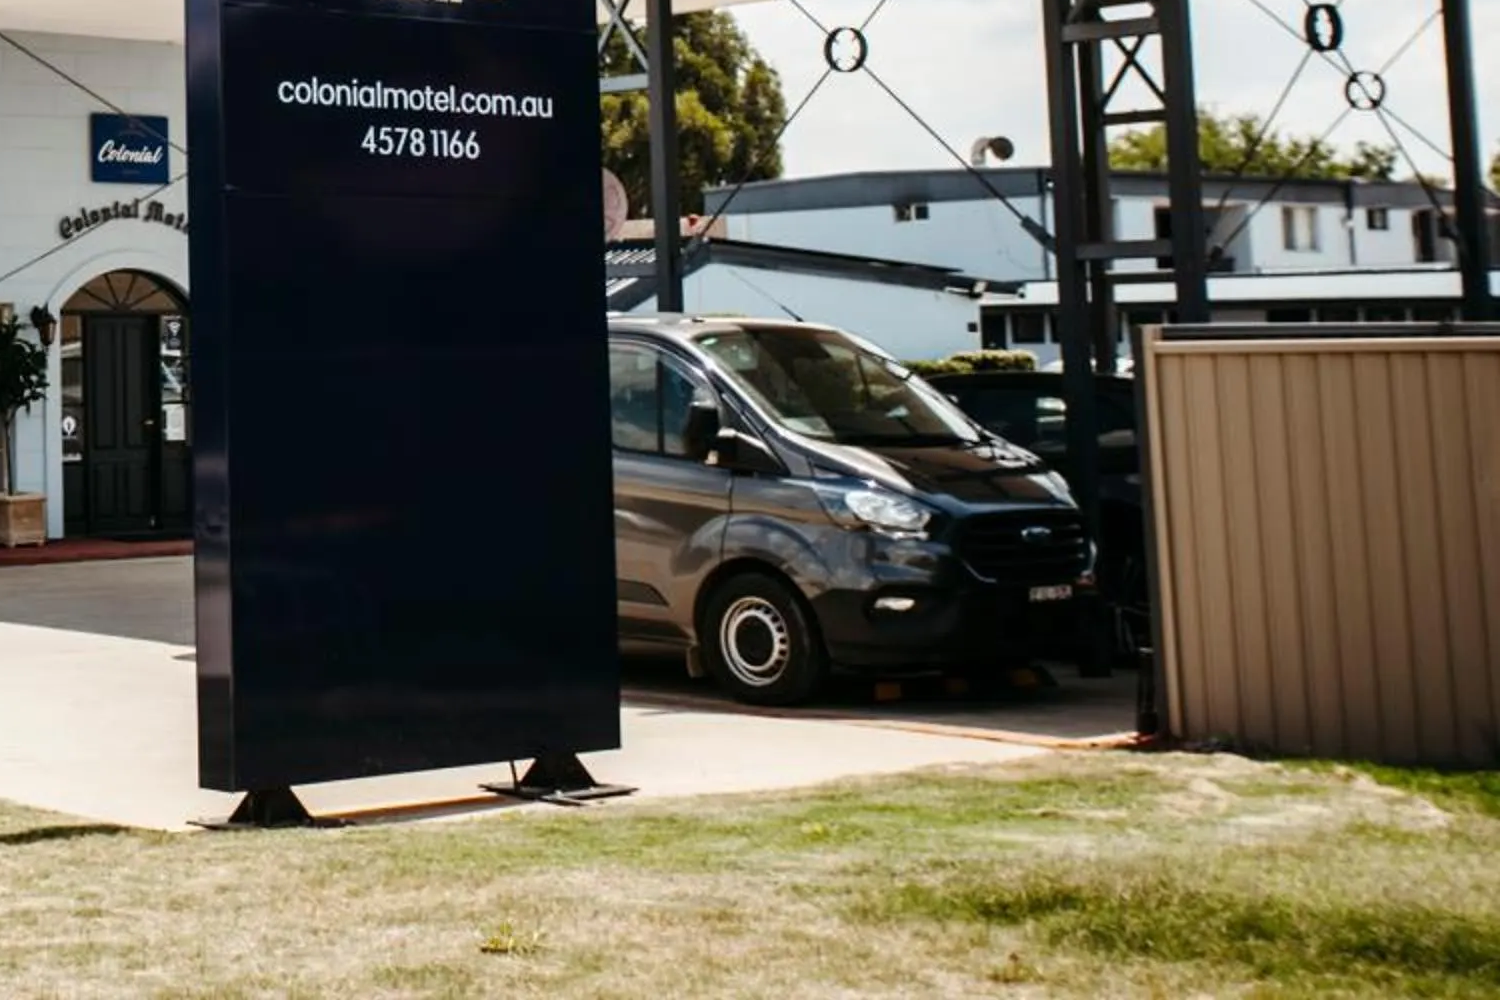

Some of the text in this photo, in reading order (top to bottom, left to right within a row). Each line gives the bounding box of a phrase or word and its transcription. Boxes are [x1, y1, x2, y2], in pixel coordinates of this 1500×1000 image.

[277, 76, 553, 118] colonialmotel.com.au
[97, 139, 164, 164] Colonial
[361, 126, 480, 160] 4578 1166
[58, 197, 140, 240] Colonial
